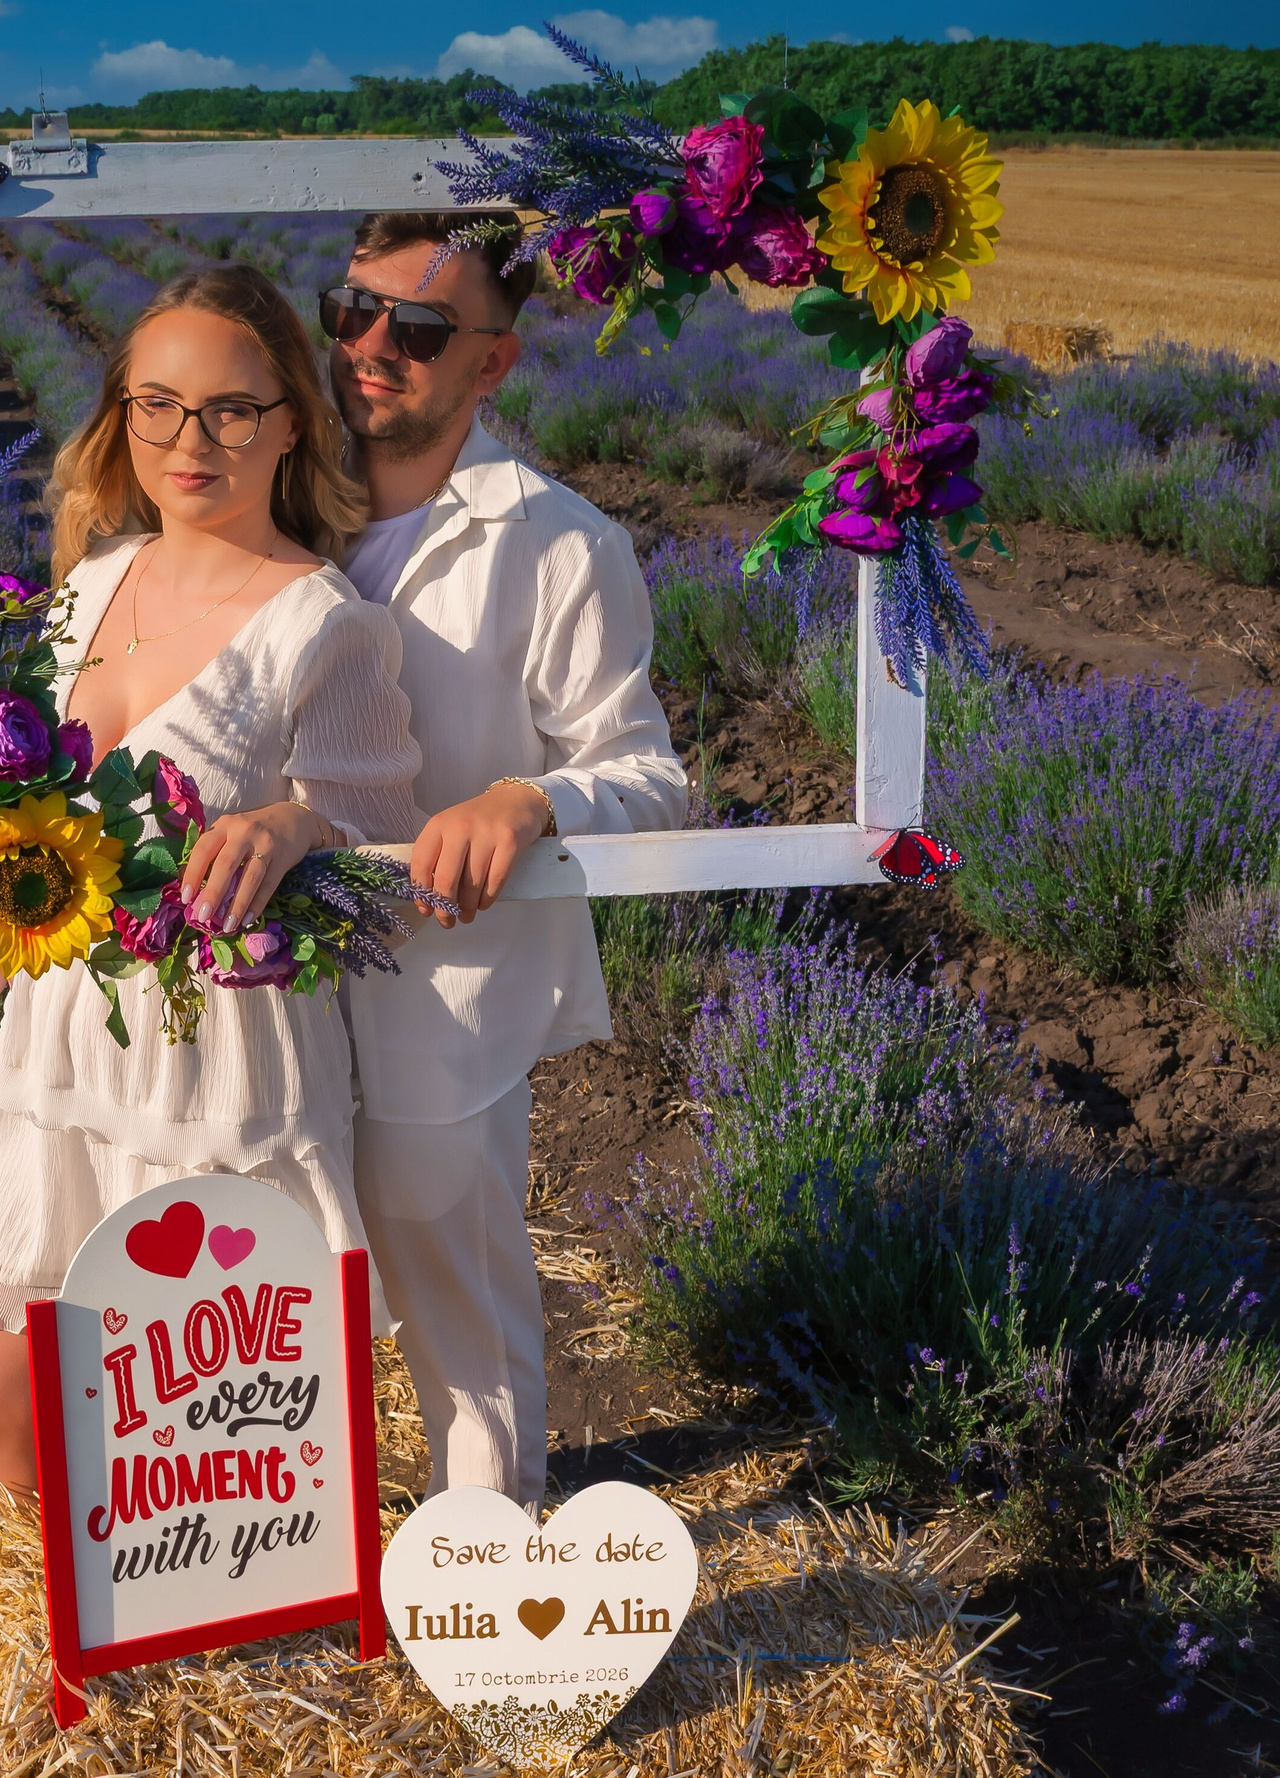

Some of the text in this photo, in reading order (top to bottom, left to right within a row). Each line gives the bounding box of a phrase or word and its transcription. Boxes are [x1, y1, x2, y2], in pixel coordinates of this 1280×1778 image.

[104, 1283, 312, 1439] I LOVE
[186, 1371, 320, 1437] every
[112, 1510, 321, 1583] with you
[430, 1532, 668, 1568] Save the date
[404, 1598, 672, 1641] Iulia Alin
[454, 1667, 629, 1687] 17 Octombrie 2026
